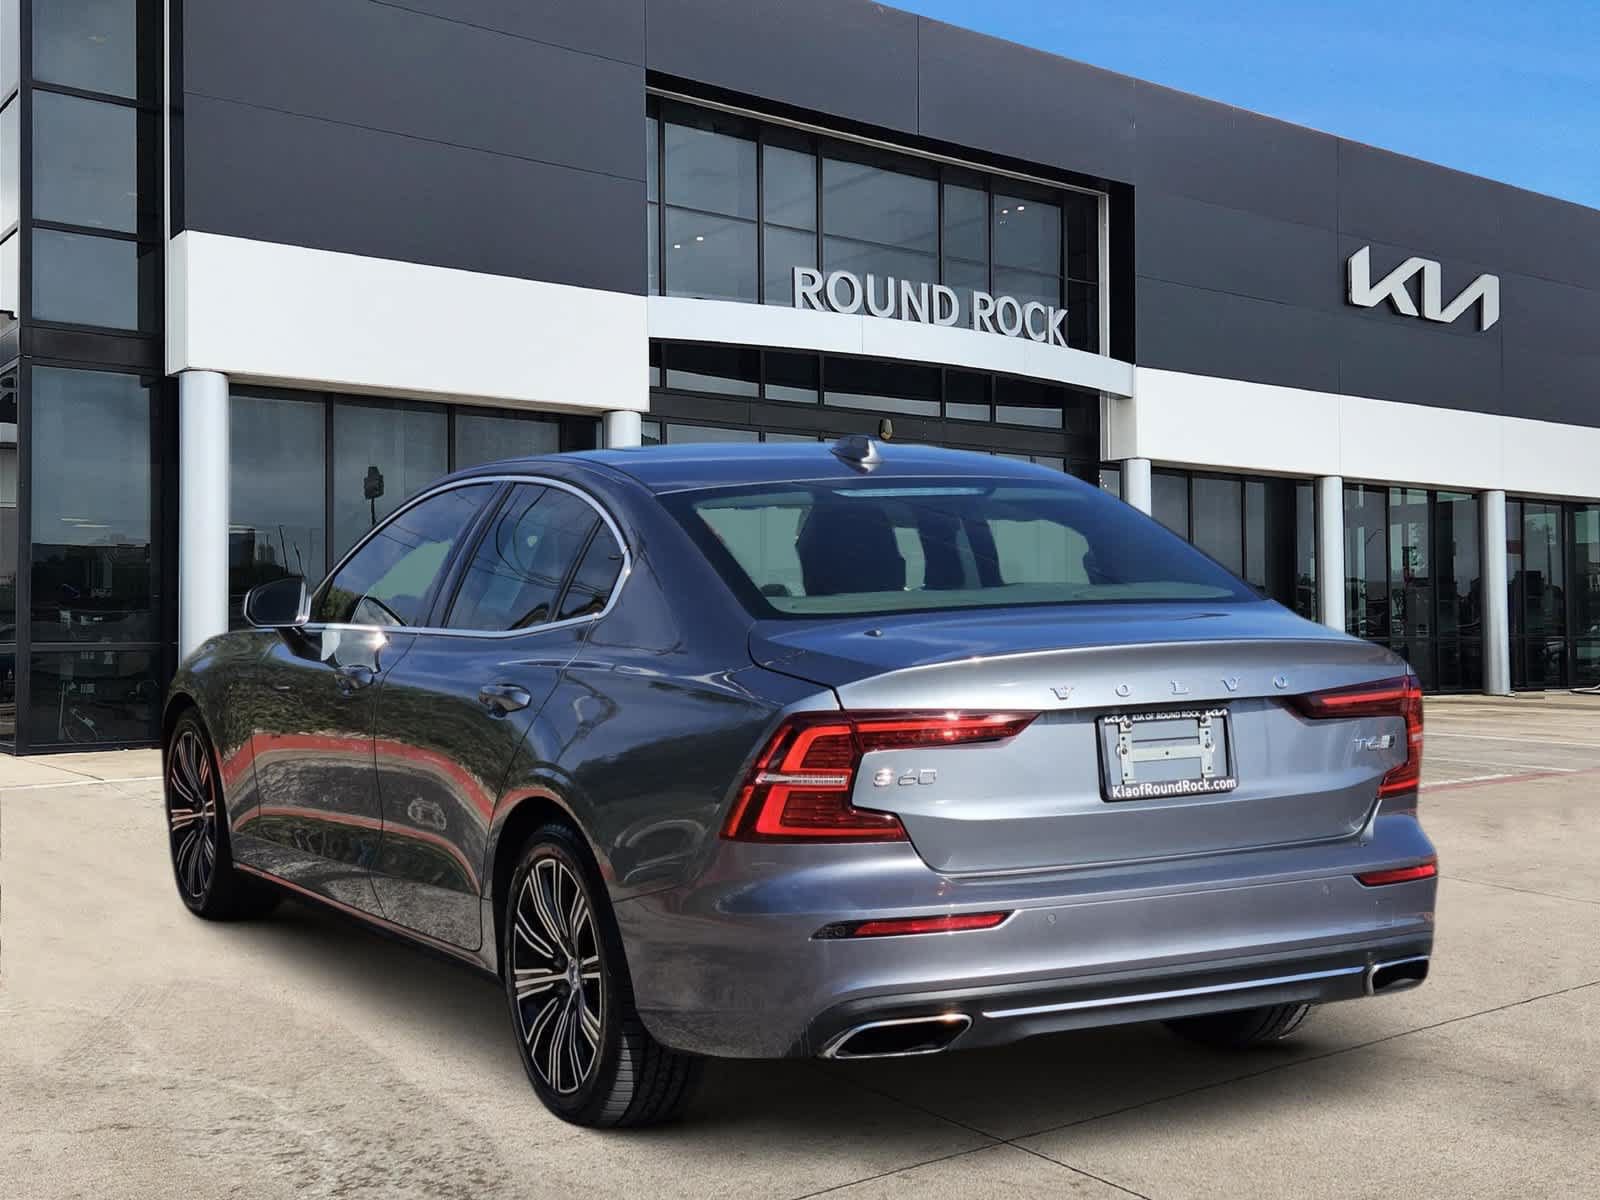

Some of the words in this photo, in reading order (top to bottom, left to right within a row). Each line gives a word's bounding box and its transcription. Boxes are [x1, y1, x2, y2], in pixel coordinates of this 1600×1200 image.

[1347, 245, 1499, 332] KIA
[792, 266, 960, 327] ROUND
[971, 290, 1069, 347] ROCK
[1050, 675, 1289, 700] VOLVO
[1155, 710, 1181, 720] ROUND
[873, 767, 937, 787] S60
[1111, 778, 1237, 799] KiaofRoundRock.com
